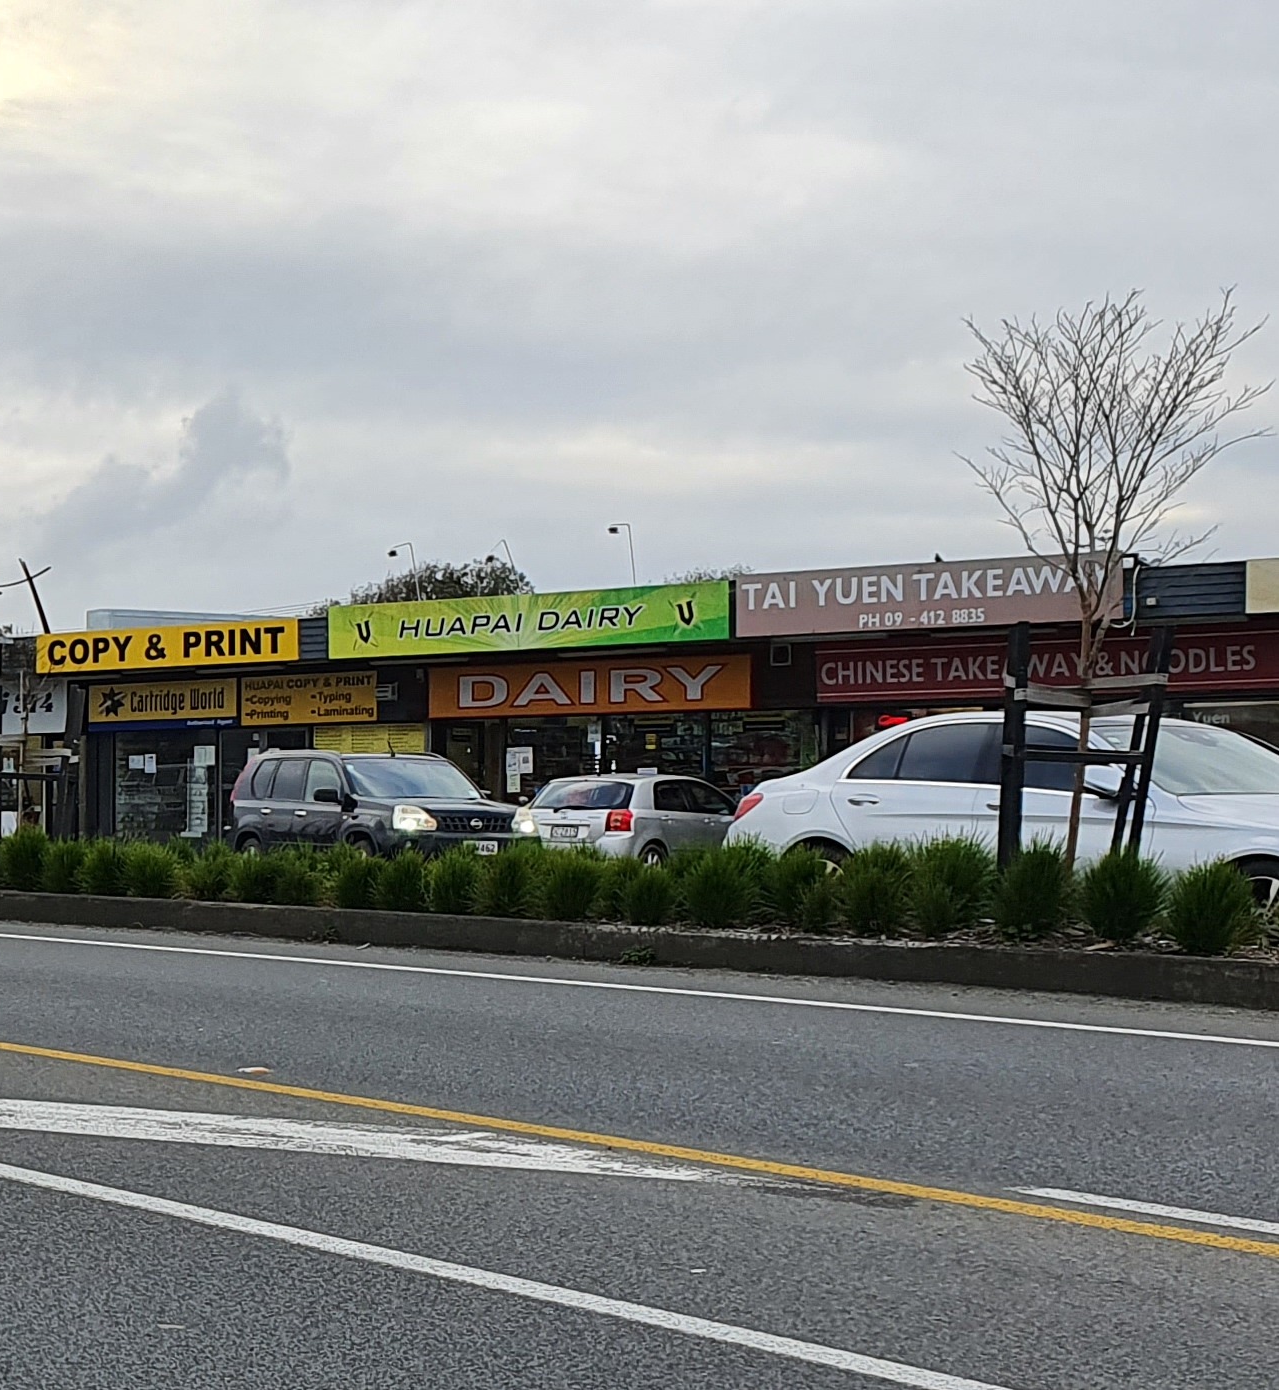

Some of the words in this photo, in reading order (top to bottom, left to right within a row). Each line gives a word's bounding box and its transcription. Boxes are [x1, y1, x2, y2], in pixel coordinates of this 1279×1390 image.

[742, 581, 796, 610] TAI
[811, 574, 903, 606] YUEN
[398, 612, 522, 640] HUAPAI
[538, 605, 643, 632] DAIRY
[858, 613, 880, 628] PH
[884, 612, 903, 626] 09
[920, 610, 945, 625] 412
[952, 608, 985, 624] 8835
[48, 636, 133, 665] COPY
[144, 634, 166, 661] &
[183, 627, 285, 658] PRINT
[821, 658, 925, 685] CHINESE
[930, 653, 1087, 682] TAKEWAY
[1096, 652, 1114, 676] &
[1121, 645, 1257, 675] NODLES
[244, 680, 283, 690] HUAPAI
[286, 678, 319, 689] COPY
[335, 675, 373, 686] PRINT
[458, 665, 724, 709] DAIRY
[130, 690, 185, 715] Cartridge
[190, 687, 225, 711] World
[250, 694, 292, 706] Copying
[316, 692, 352, 704] Typing
[250, 708, 289, 720] Printing
[317, 706, 374, 717] Laminating
[1193, 711, 1231, 724] Yuen
